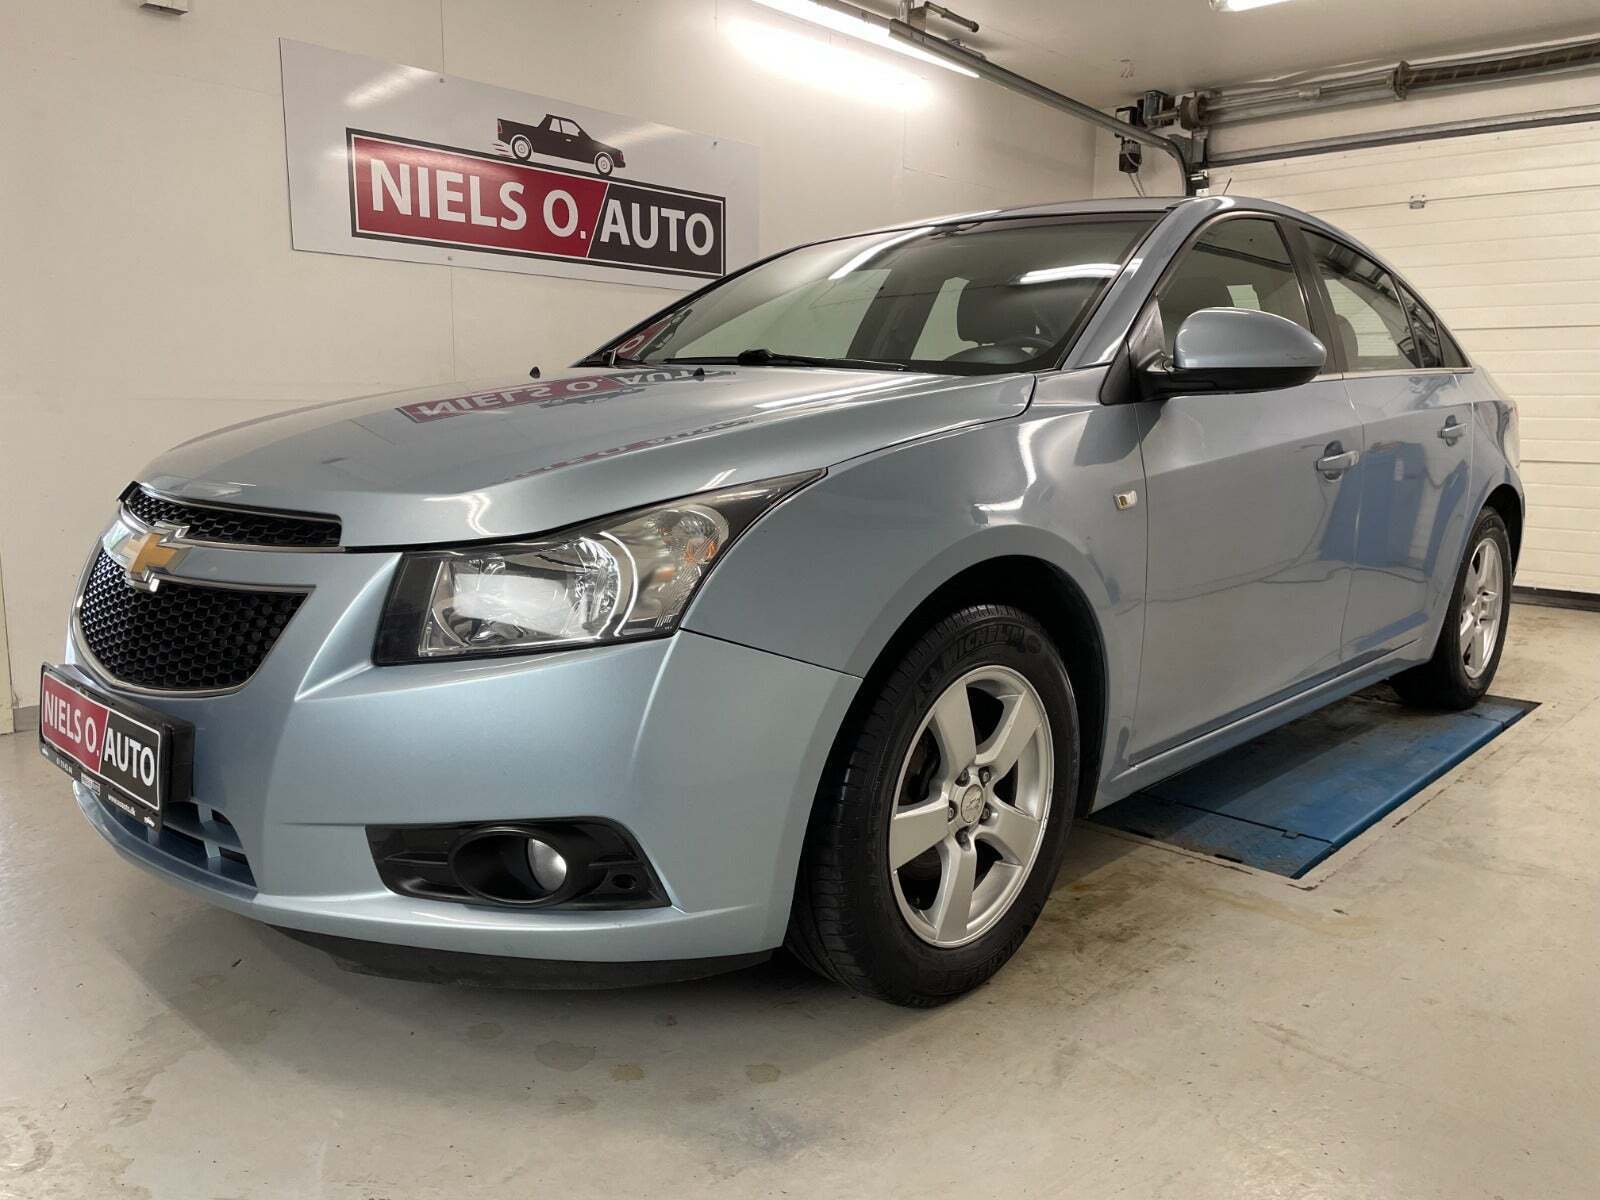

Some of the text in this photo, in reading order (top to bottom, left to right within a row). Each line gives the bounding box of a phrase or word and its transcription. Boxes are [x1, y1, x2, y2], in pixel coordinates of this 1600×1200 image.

[370, 158, 714, 256] NIELS O. AUTO
[44, 691, 81, 744] NIELS
[84, 716, 99, 757] O.
[103, 727, 155, 786] AUTO
